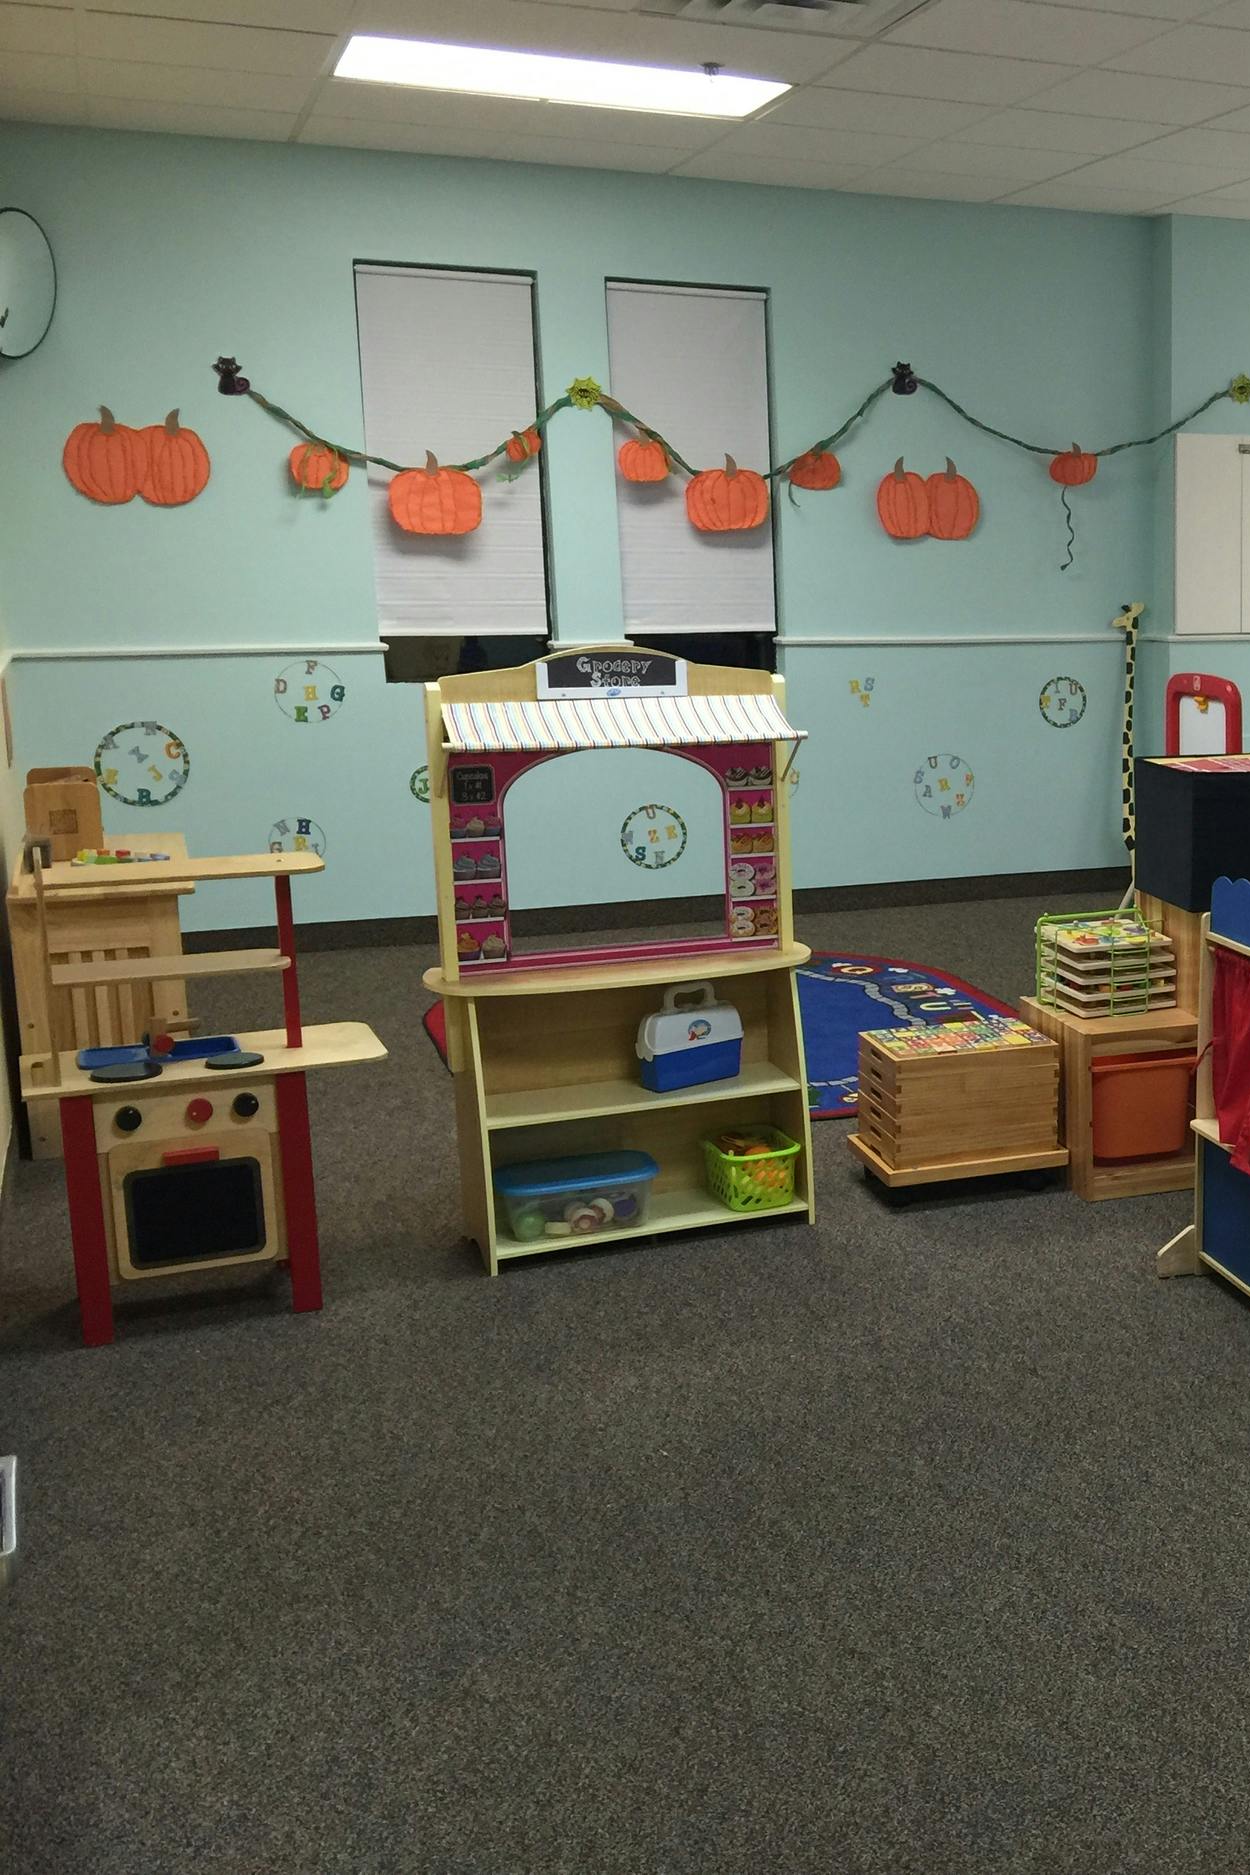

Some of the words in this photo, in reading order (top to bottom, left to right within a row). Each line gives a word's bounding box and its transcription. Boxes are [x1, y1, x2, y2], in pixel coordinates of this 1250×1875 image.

[576, 657, 652, 674] Grocery
[275, 678, 287, 694] D
[590, 671, 641, 687] Store
[137, 788, 152, 806] B
[922, 784, 933, 798] A
[296, 819, 311, 835] H
[635, 846, 647, 861] S
[841, 966, 874, 975] Q
